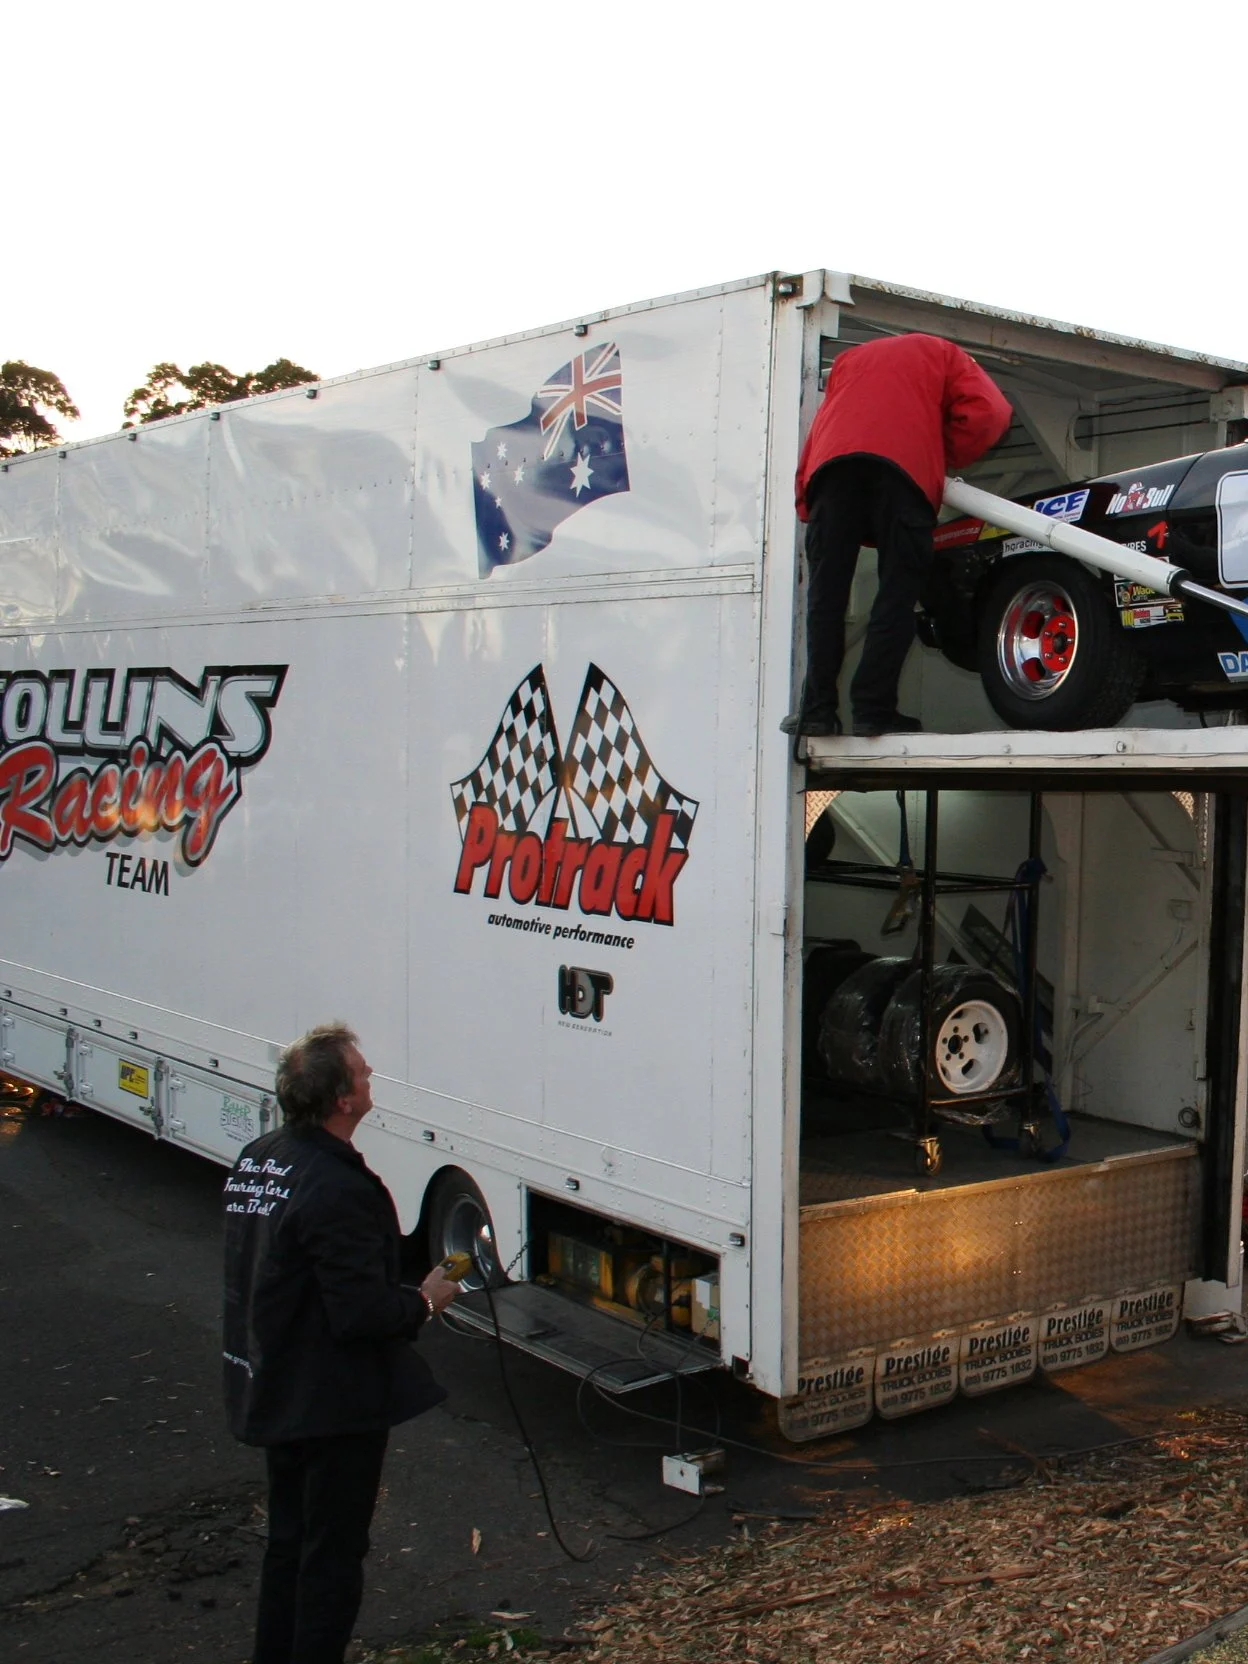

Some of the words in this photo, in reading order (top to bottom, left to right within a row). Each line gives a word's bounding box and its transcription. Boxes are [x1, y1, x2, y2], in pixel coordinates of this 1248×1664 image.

[1036, 489, 1087, 516] ICE
[1105, 493, 1128, 515] No
[1142, 484, 1175, 509] Bull
[0, 664, 289, 768] OLLINS
[0, 736, 242, 867] Racing
[105, 851, 170, 897] TEAM
[453, 801, 689, 926] Protrack
[487, 913, 552, 935] automotive
[552, 923, 635, 949] performance
[558, 964, 614, 1022] HDT
[238, 1157, 261, 1173] The
[262, 1158, 293, 1177] Real
[223, 1177, 264, 1197] Touring
[226, 1202, 245, 1213] are
[1119, 1291, 1174, 1319] Prestige
[1047, 1308, 1104, 1336] Prestige
[1116, 1318, 1144, 1332] TRUCK
[968, 1325, 1030, 1356] Prestige
[1043, 1336, 1073, 1351] TRUCK
[1075, 1327, 1104, 1343] BODIES
[1132, 1329, 1152, 1343] 9775
[884, 1343, 950, 1377] Prestige
[964, 1355, 997, 1372] TRUCK
[999, 1345, 1032, 1362] BODIES
[1060, 1346, 1082, 1362] 9775
[798, 1365, 864, 1395] Prestige
[882, 1378, 916, 1393] TRUCK
[918, 1366, 952, 1384] BODIES
[982, 1367, 1007, 1383] 9775
[900, 1388, 926, 1405] 9775
